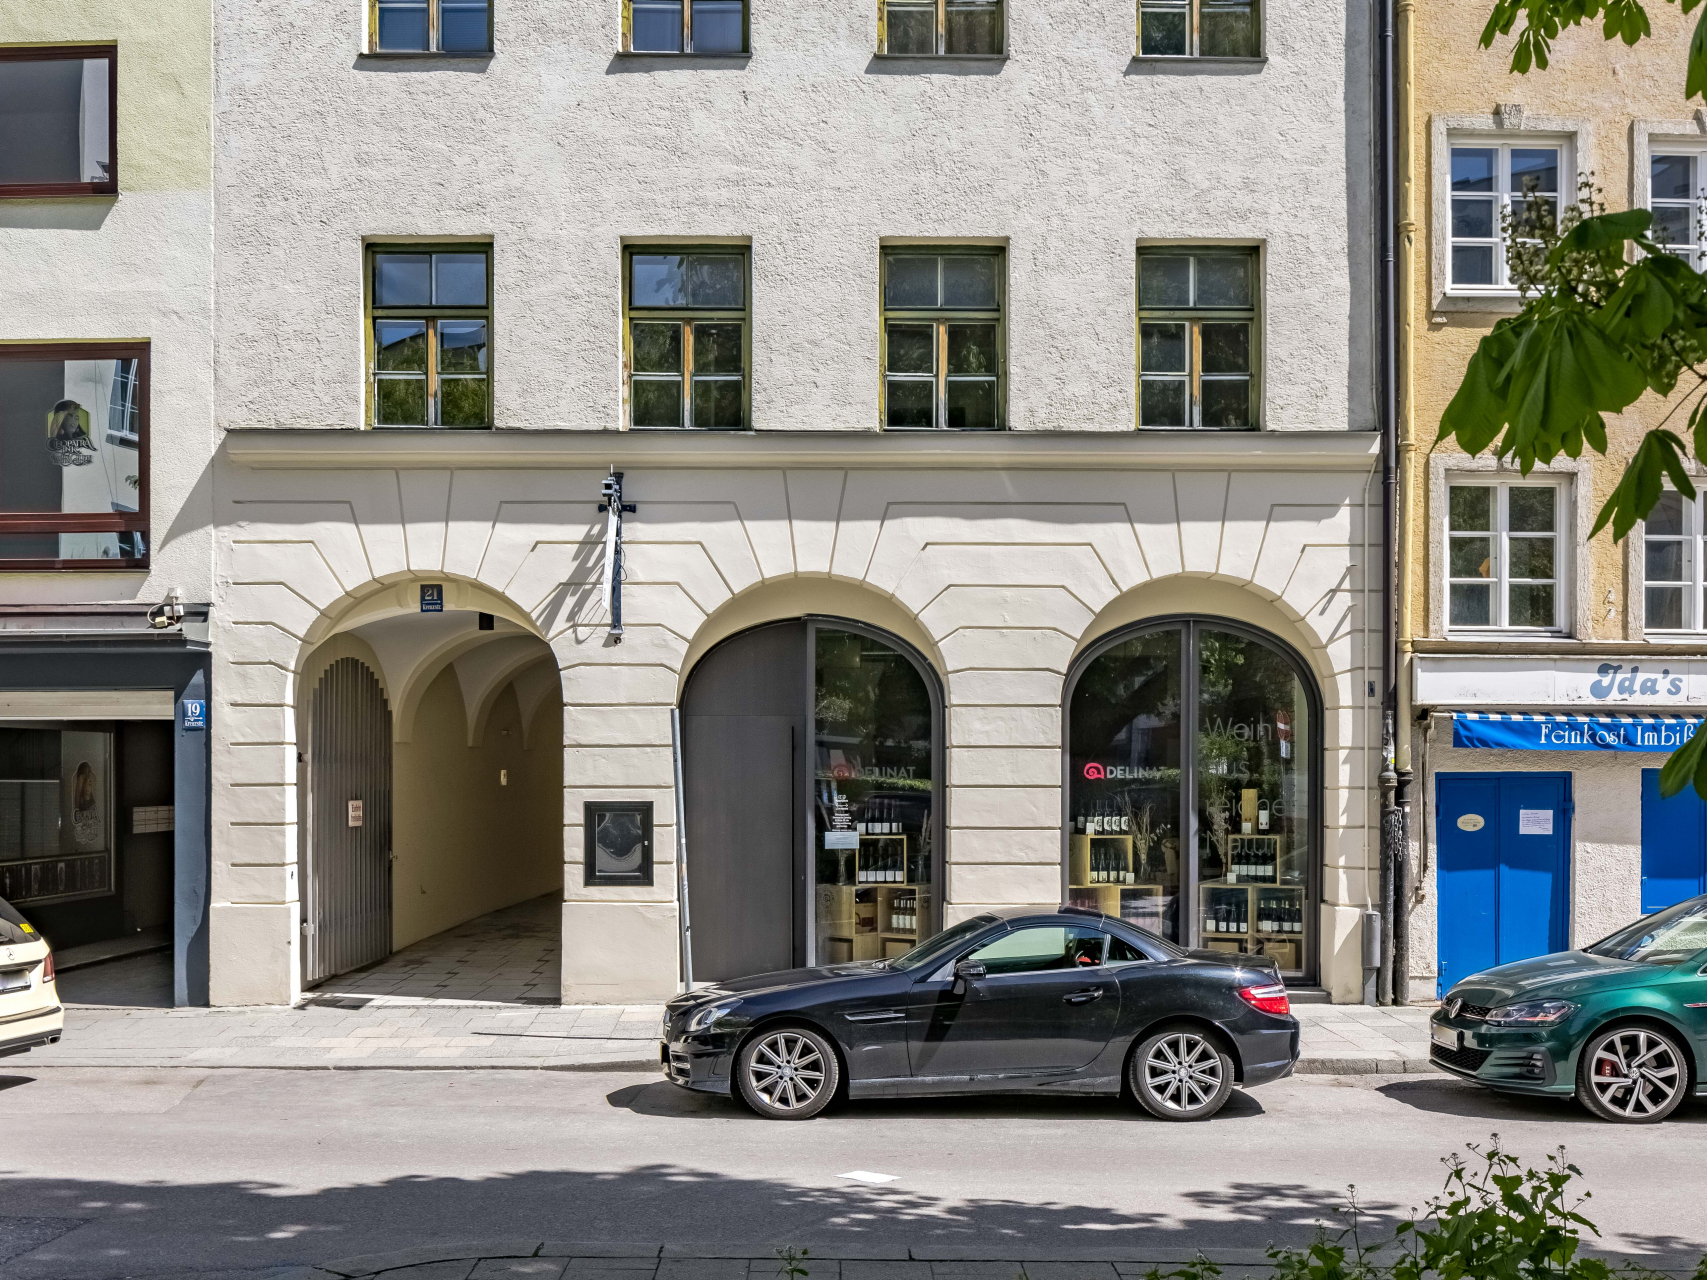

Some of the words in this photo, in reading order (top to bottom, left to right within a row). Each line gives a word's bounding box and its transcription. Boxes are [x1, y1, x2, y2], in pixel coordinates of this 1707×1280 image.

[46, 437, 97, 451] CLEOPATRA
[424, 587, 438, 600] 21
[1589, 662, 1684, 699] Ida's
[187, 703, 200, 716] 19
[1206, 717, 1272, 741] Wein
[1539, 723, 1629, 745] Feinkost
[1635, 724, 1695, 746] Imbiß
[855, 766, 916, 780] DELINAT
[1106, 765, 1168, 779] DELINAT
[1206, 830, 1278, 854] Natur
